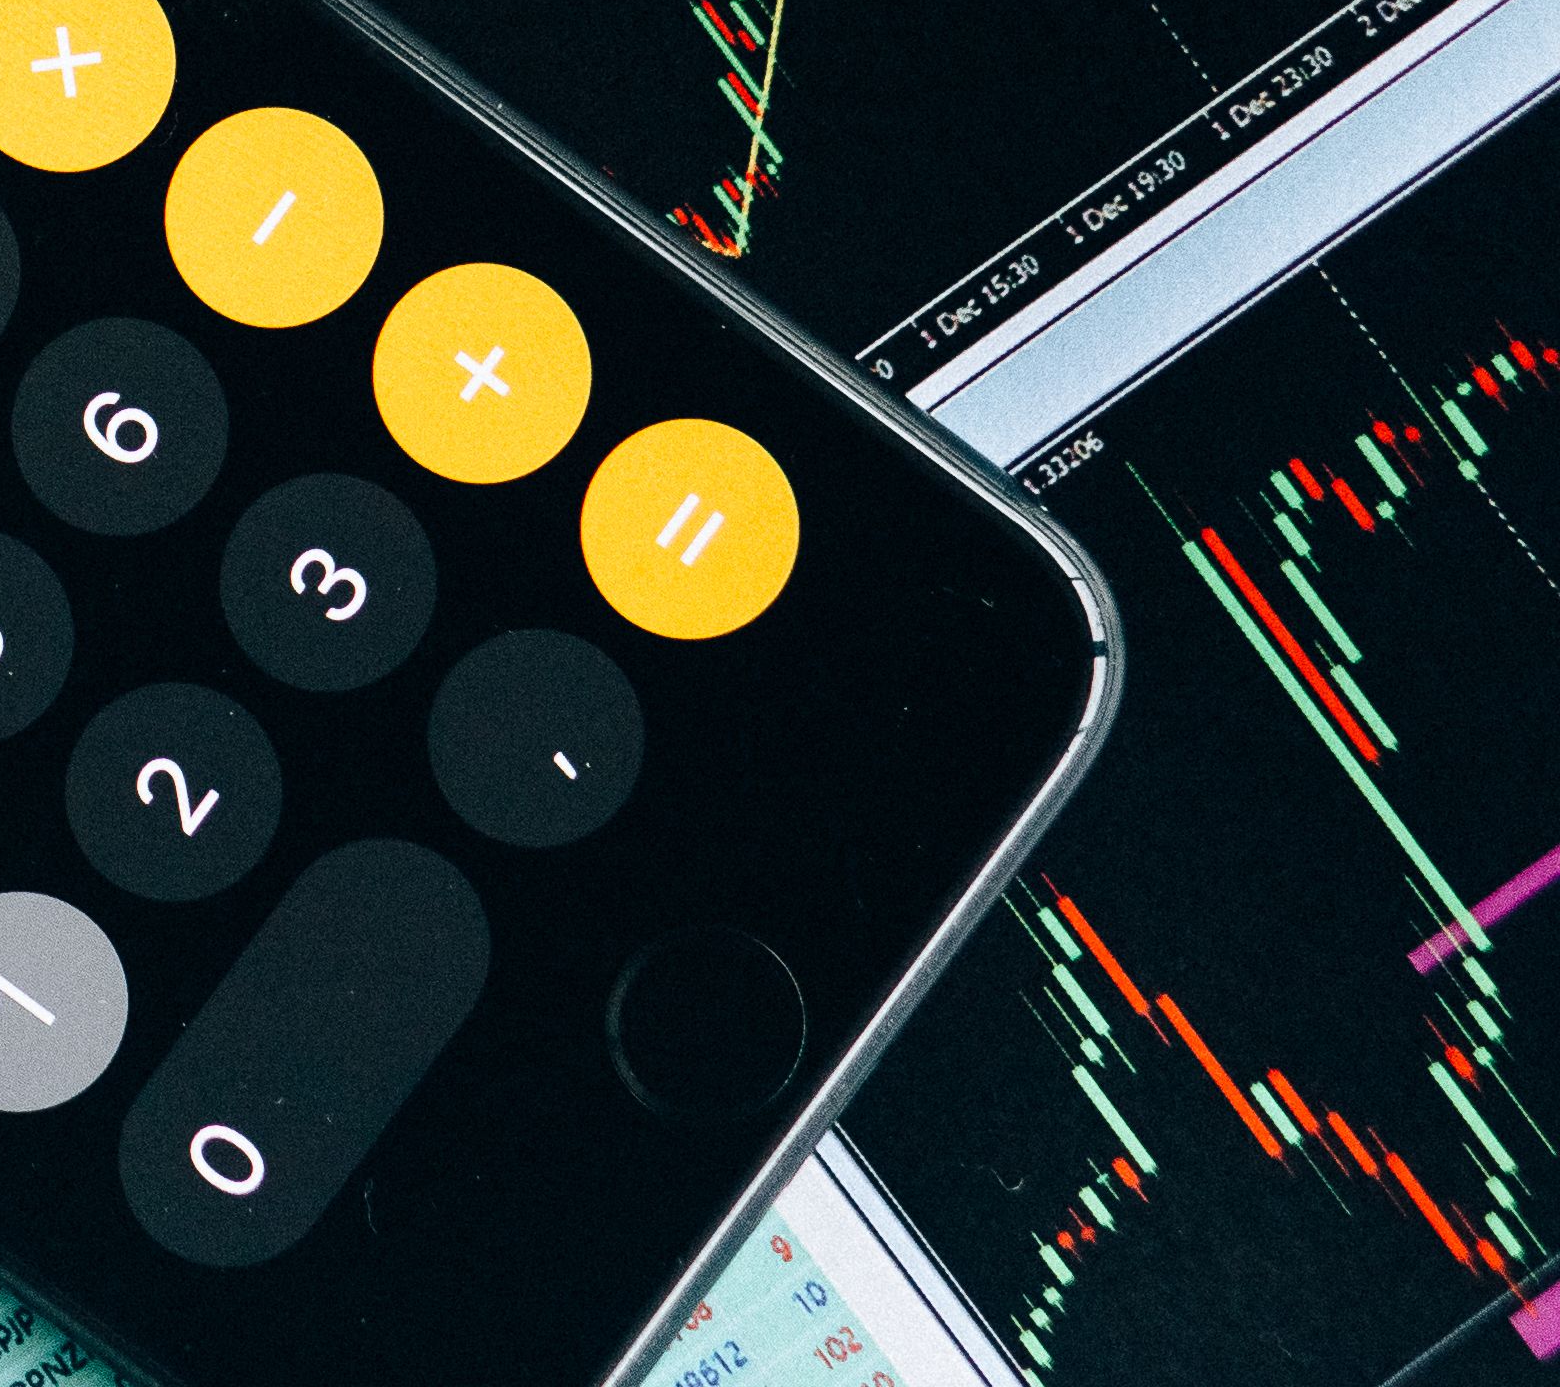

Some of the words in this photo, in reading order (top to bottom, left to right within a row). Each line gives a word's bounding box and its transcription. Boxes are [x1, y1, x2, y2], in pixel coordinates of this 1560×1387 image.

[1356, 14, 1379, 38] 2
[1211, 121, 1231, 141] 1
[1228, 90, 1277, 129] Dec
[1270, 45, 1333, 98] 23:30
[1065, 225, 1085, 245] 1
[1081, 194, 1129, 232] Dec
[1127, 150, 1186, 201] 19:30
[920, 330, 938, 350] 1
[936, 298, 983, 337] Dec
[981, 254, 1040, 305] 15:30
[84, 392, 158, 463] 6
[291, 549, 366, 620] 3
[137, 758, 219, 835] 2
[191, 1126, 263, 1193] 0
[769, 1234, 794, 1263] 9
[791, 1280, 828, 1316] 10
[813, 1326, 863, 1370] 102
